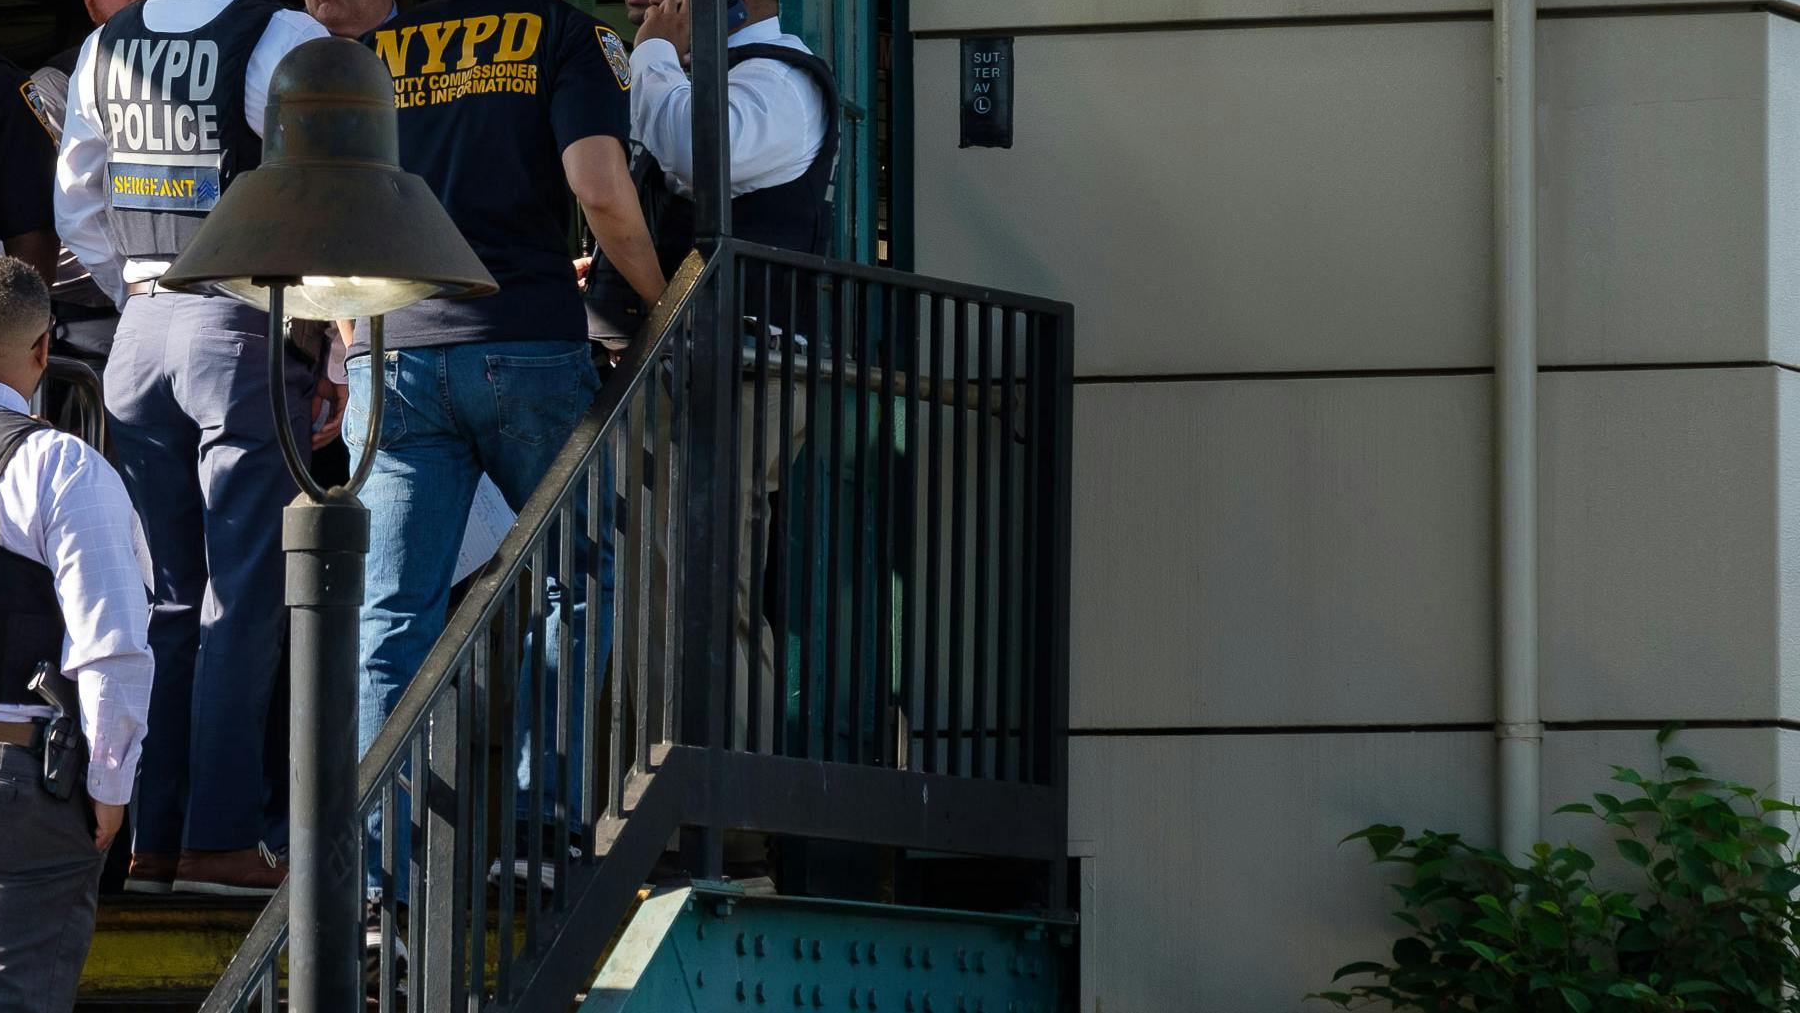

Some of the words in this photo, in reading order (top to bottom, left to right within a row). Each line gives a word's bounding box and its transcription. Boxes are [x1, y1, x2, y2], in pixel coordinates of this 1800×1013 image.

[375, 12, 543, 78] NYPD
[973, 52, 1006, 64] SUT-
[106, 38, 220, 102] NYPD
[428, 63, 538, 91] COMMISSIONER
[973, 67, 1001, 78] TER
[393, 91, 426, 109] BLIC
[430, 77, 537, 105] INFORMATION
[973, 83, 991, 93] AV
[107, 102, 221, 152] POLICE
[113, 175, 195, 198] SERGEANT
